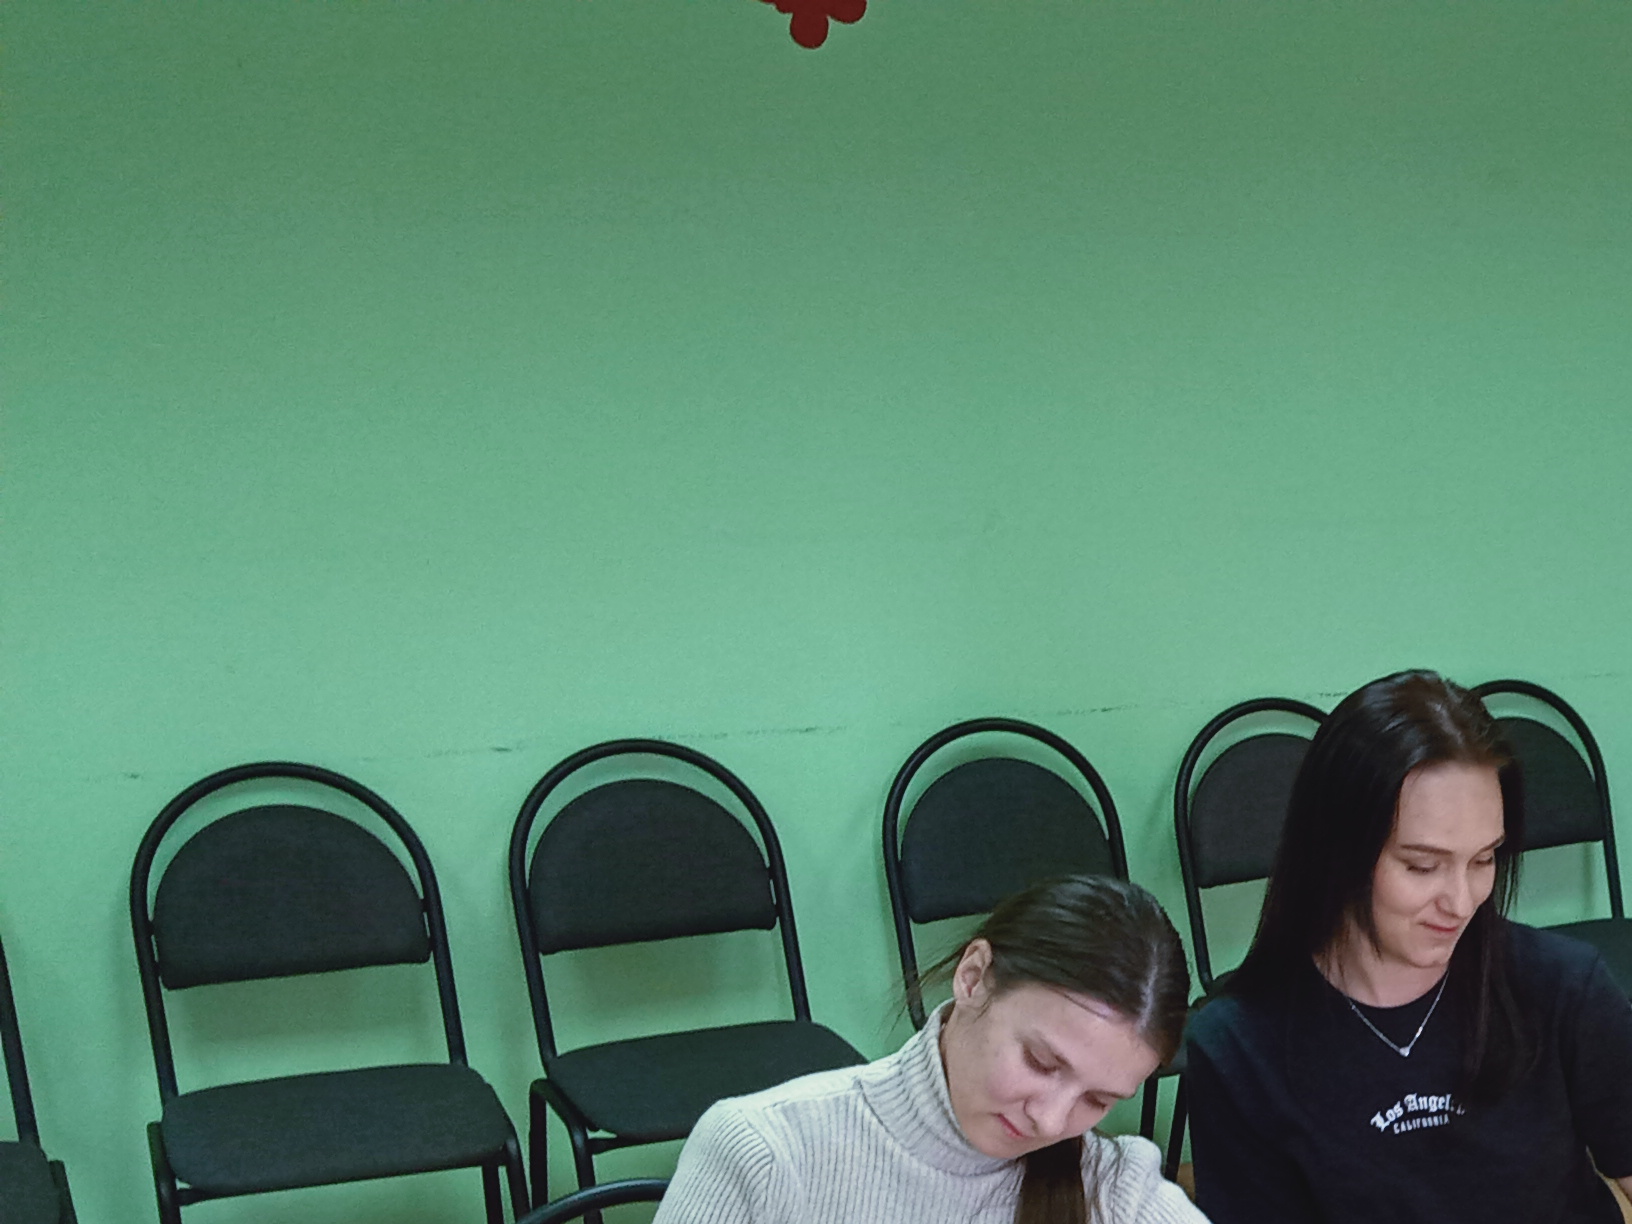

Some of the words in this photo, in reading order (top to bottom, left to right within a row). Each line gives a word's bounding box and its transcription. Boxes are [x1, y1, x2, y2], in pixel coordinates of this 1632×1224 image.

[1370, 1101, 1404, 1133] Los
[1404, 1092, 1465, 1116] Angel
[1393, 1113, 1450, 1135] CALIFORNIA
